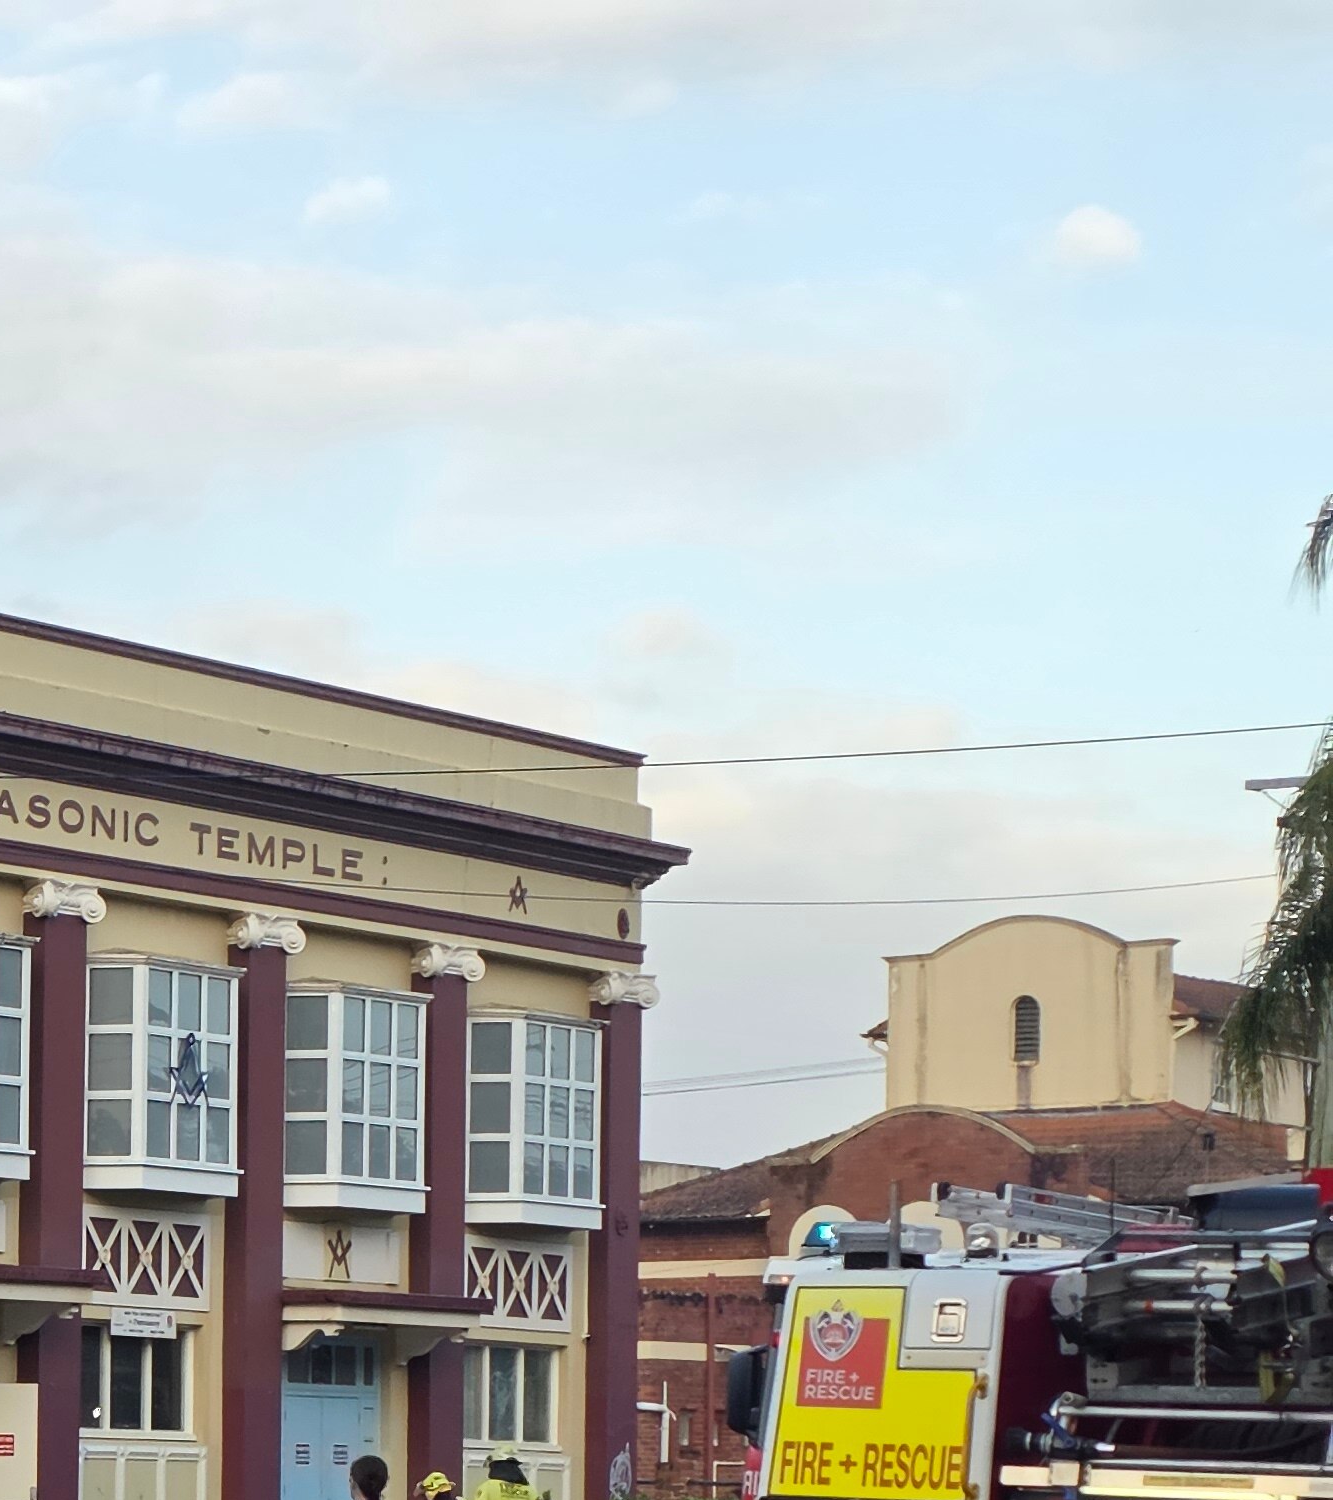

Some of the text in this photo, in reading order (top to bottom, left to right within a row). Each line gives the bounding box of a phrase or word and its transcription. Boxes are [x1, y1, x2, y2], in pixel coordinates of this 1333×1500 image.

[189, 822, 364, 882] TEMPLE
[805, 1368, 846, 1384] FIRE
[804, 1385, 876, 1401] RESCUE
[779, 1440, 834, 1486] FIRE
[861, 1443, 964, 1491] RESCUE
